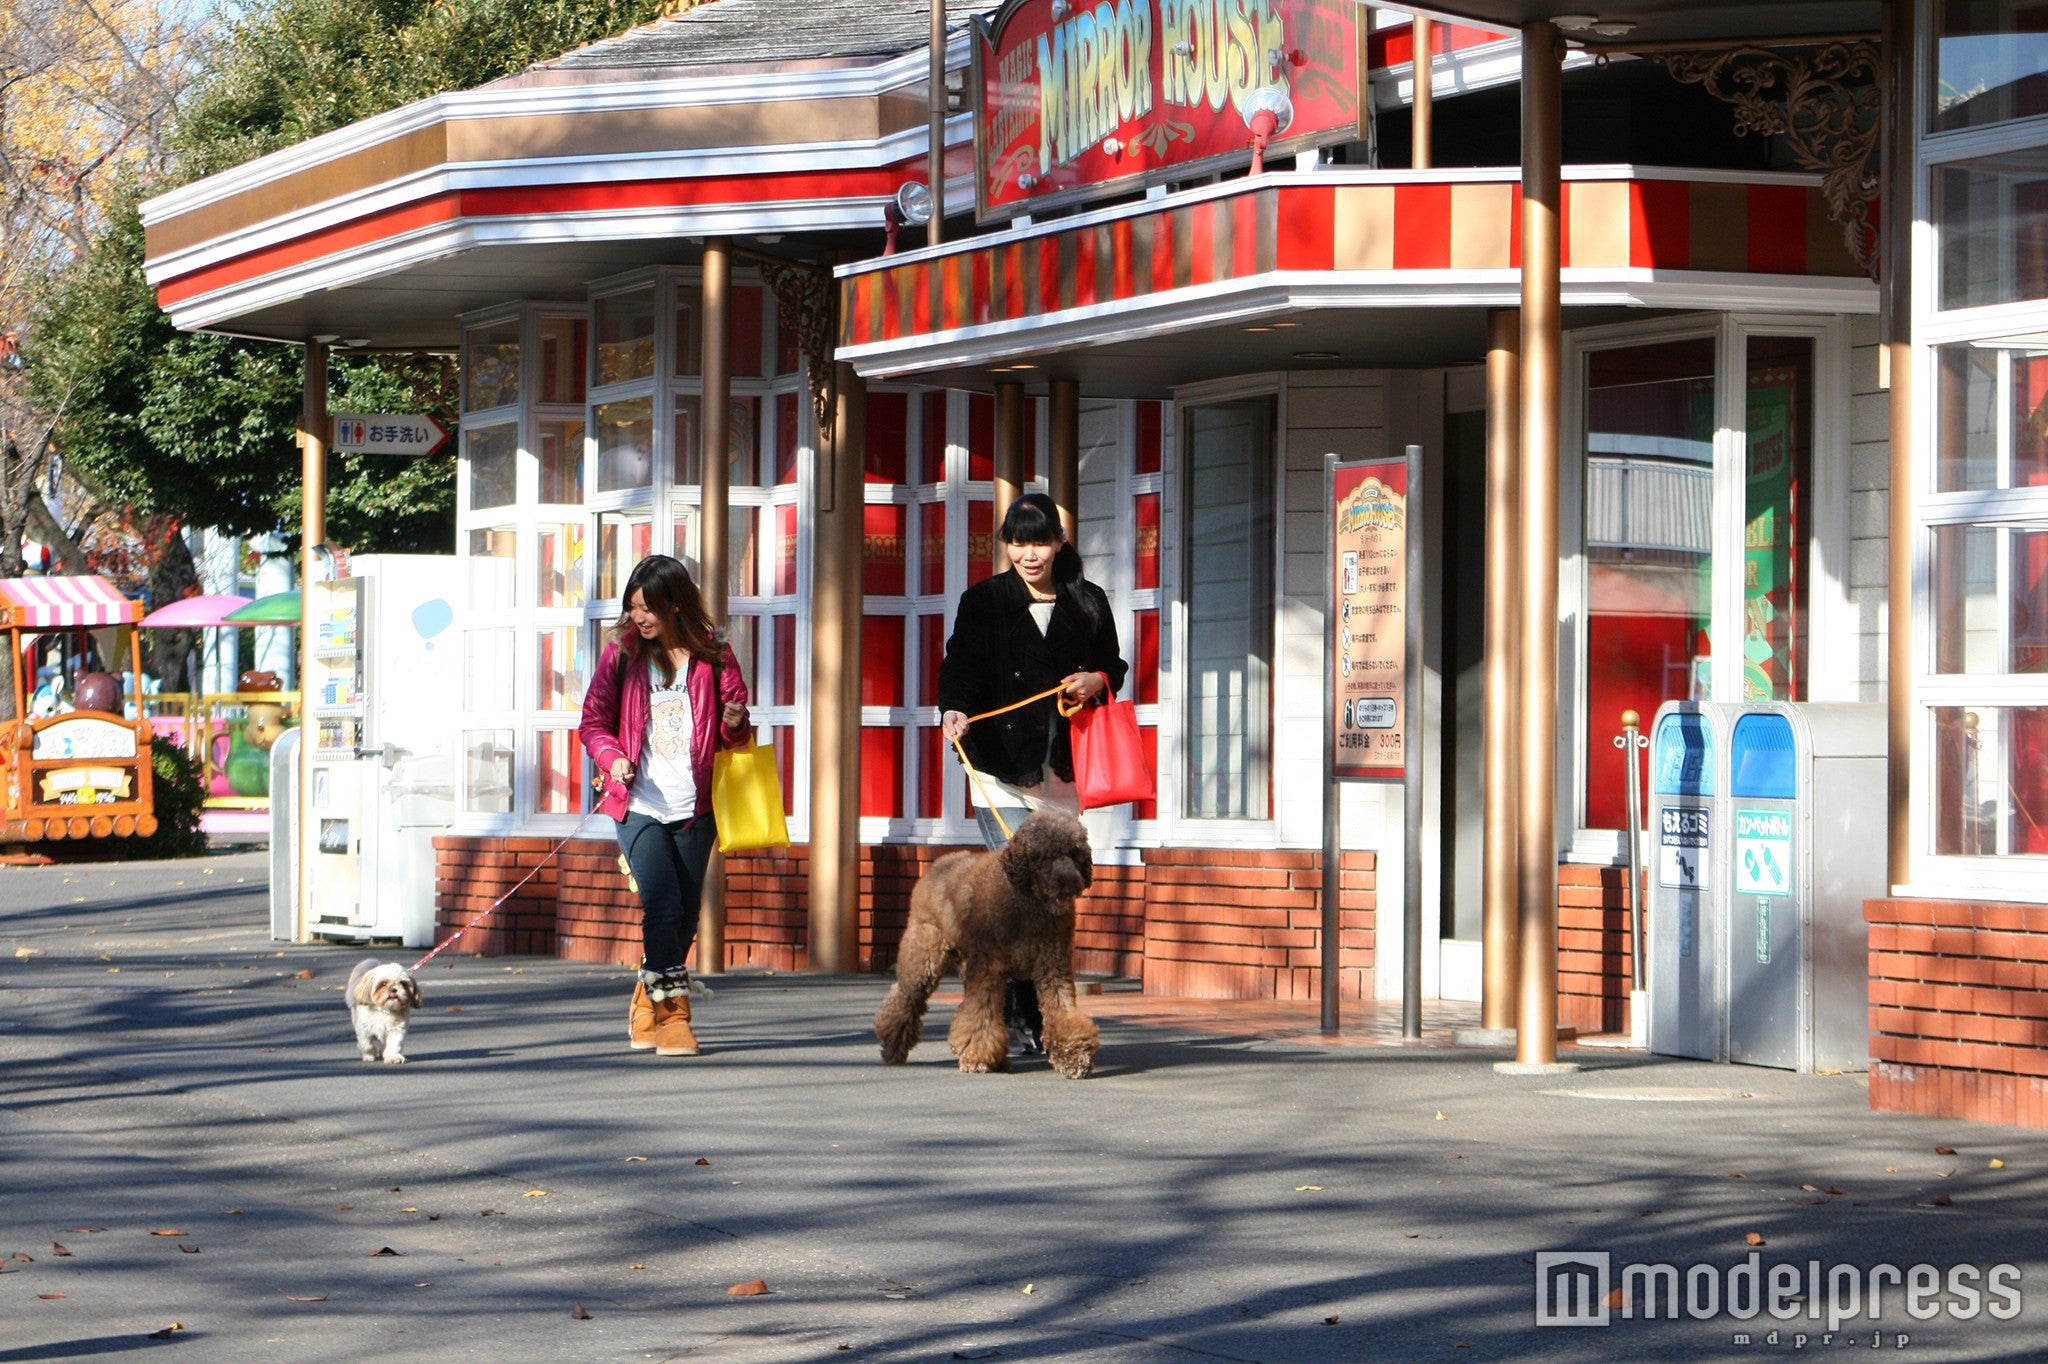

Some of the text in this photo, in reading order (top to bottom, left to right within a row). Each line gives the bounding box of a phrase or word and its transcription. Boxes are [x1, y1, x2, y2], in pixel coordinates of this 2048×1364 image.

[1037, 0, 1290, 177] MIRROR HOUSE
[369, 425, 429, 444] お手洗い
[1339, 733, 1401, 749] ご利用料金 300円
[1662, 810, 1708, 835] もえるゴミ
